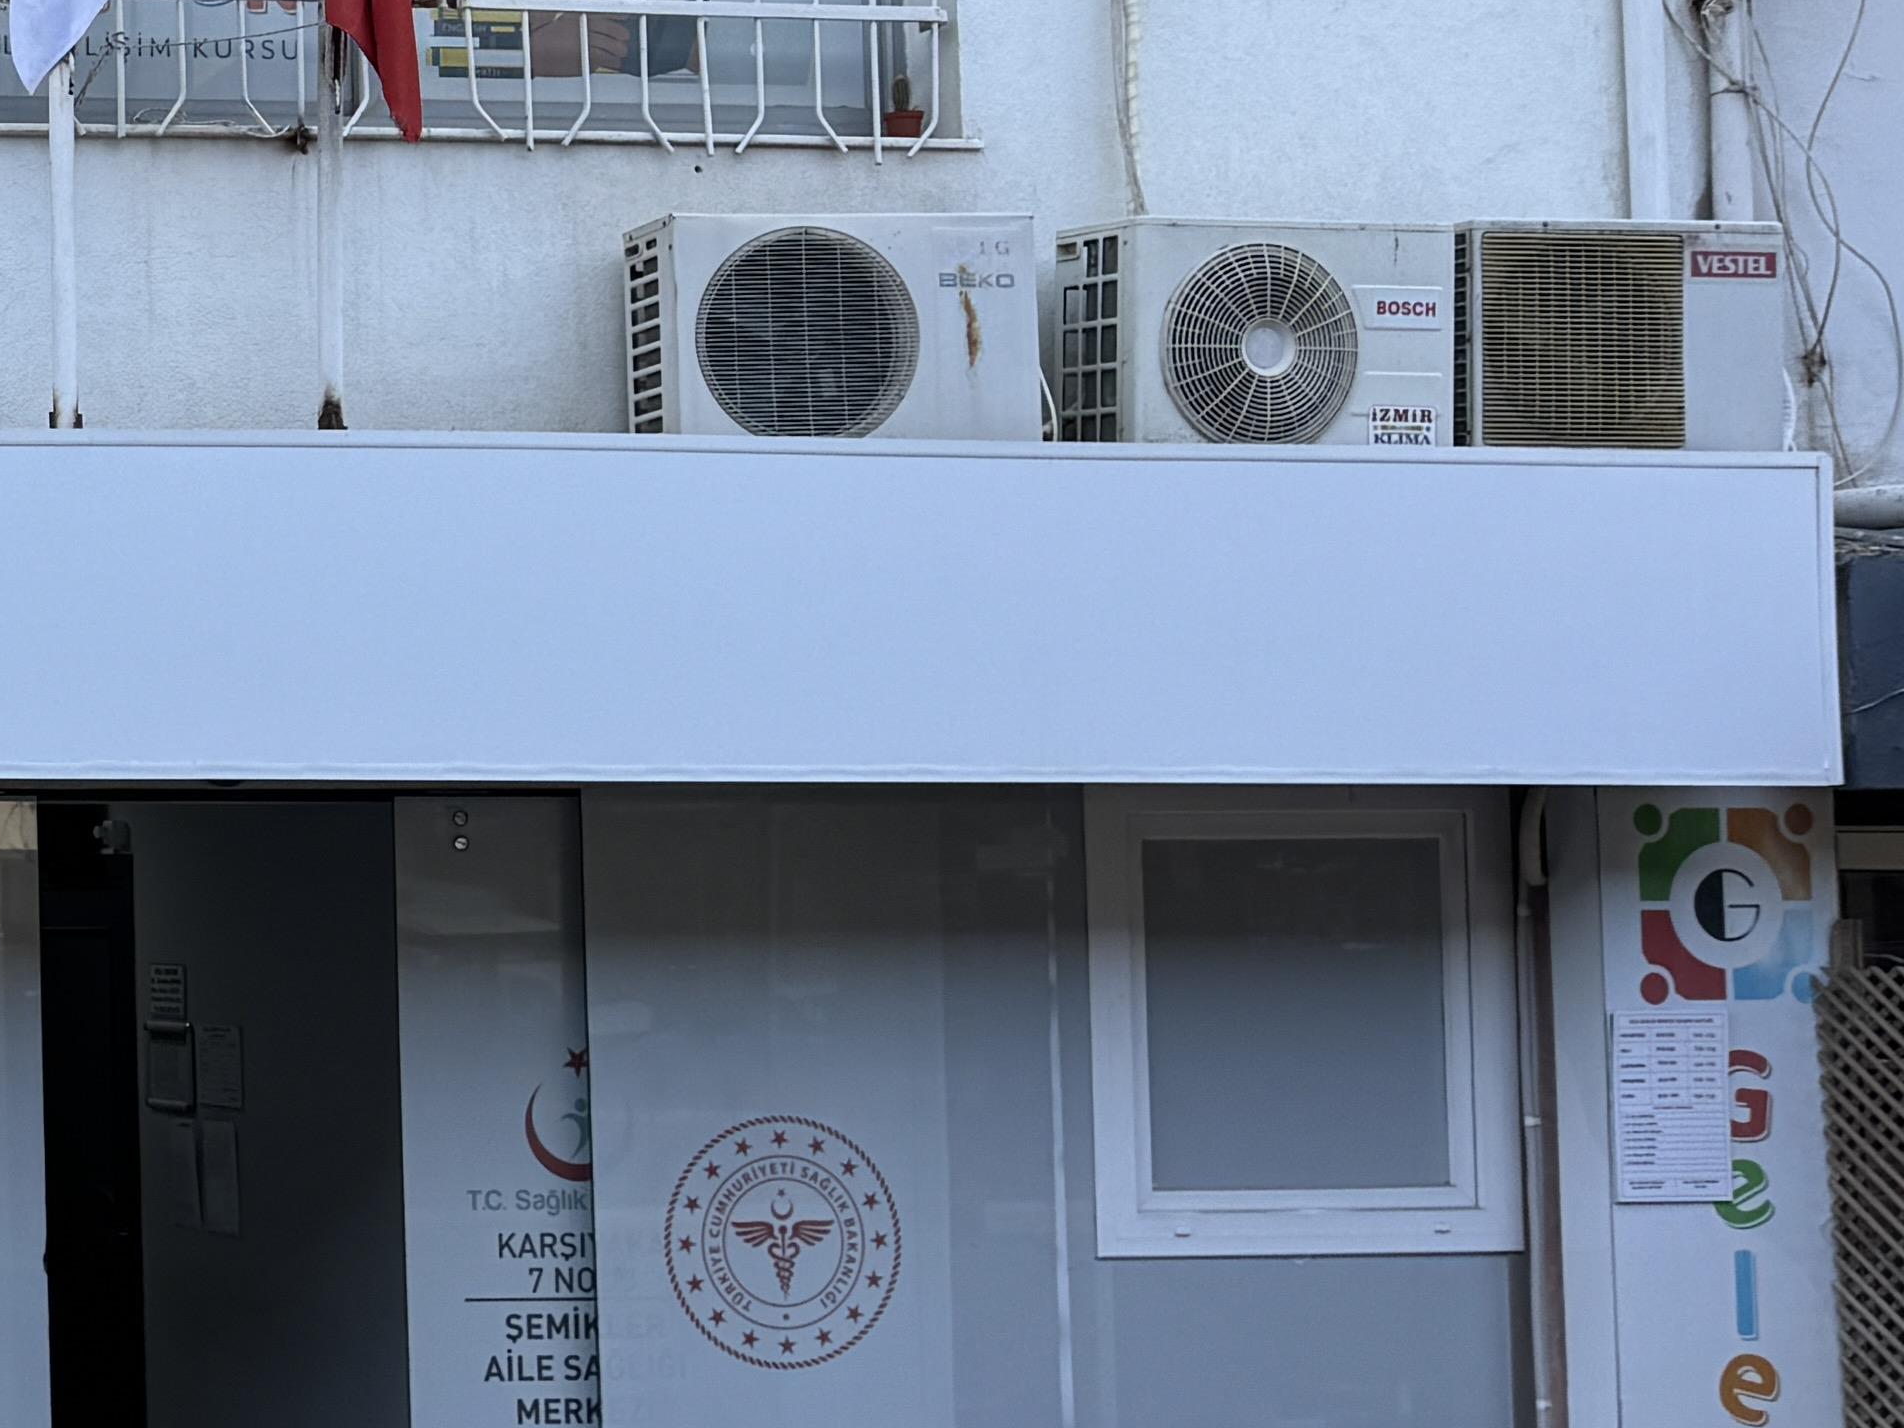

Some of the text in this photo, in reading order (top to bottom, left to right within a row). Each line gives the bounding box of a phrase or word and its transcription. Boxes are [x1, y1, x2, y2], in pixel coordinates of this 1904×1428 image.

[194, 37, 300, 60] KURSU
[1695, 254, 1772, 275] VESTEL
[938, 273, 1015, 289] BEKO
[1376, 300, 1437, 318] BOSCH
[514, 1189, 587, 1216] Sağlık
[528, 1267, 544, 1293] 7
[483, 1348, 556, 1383] AİLE
